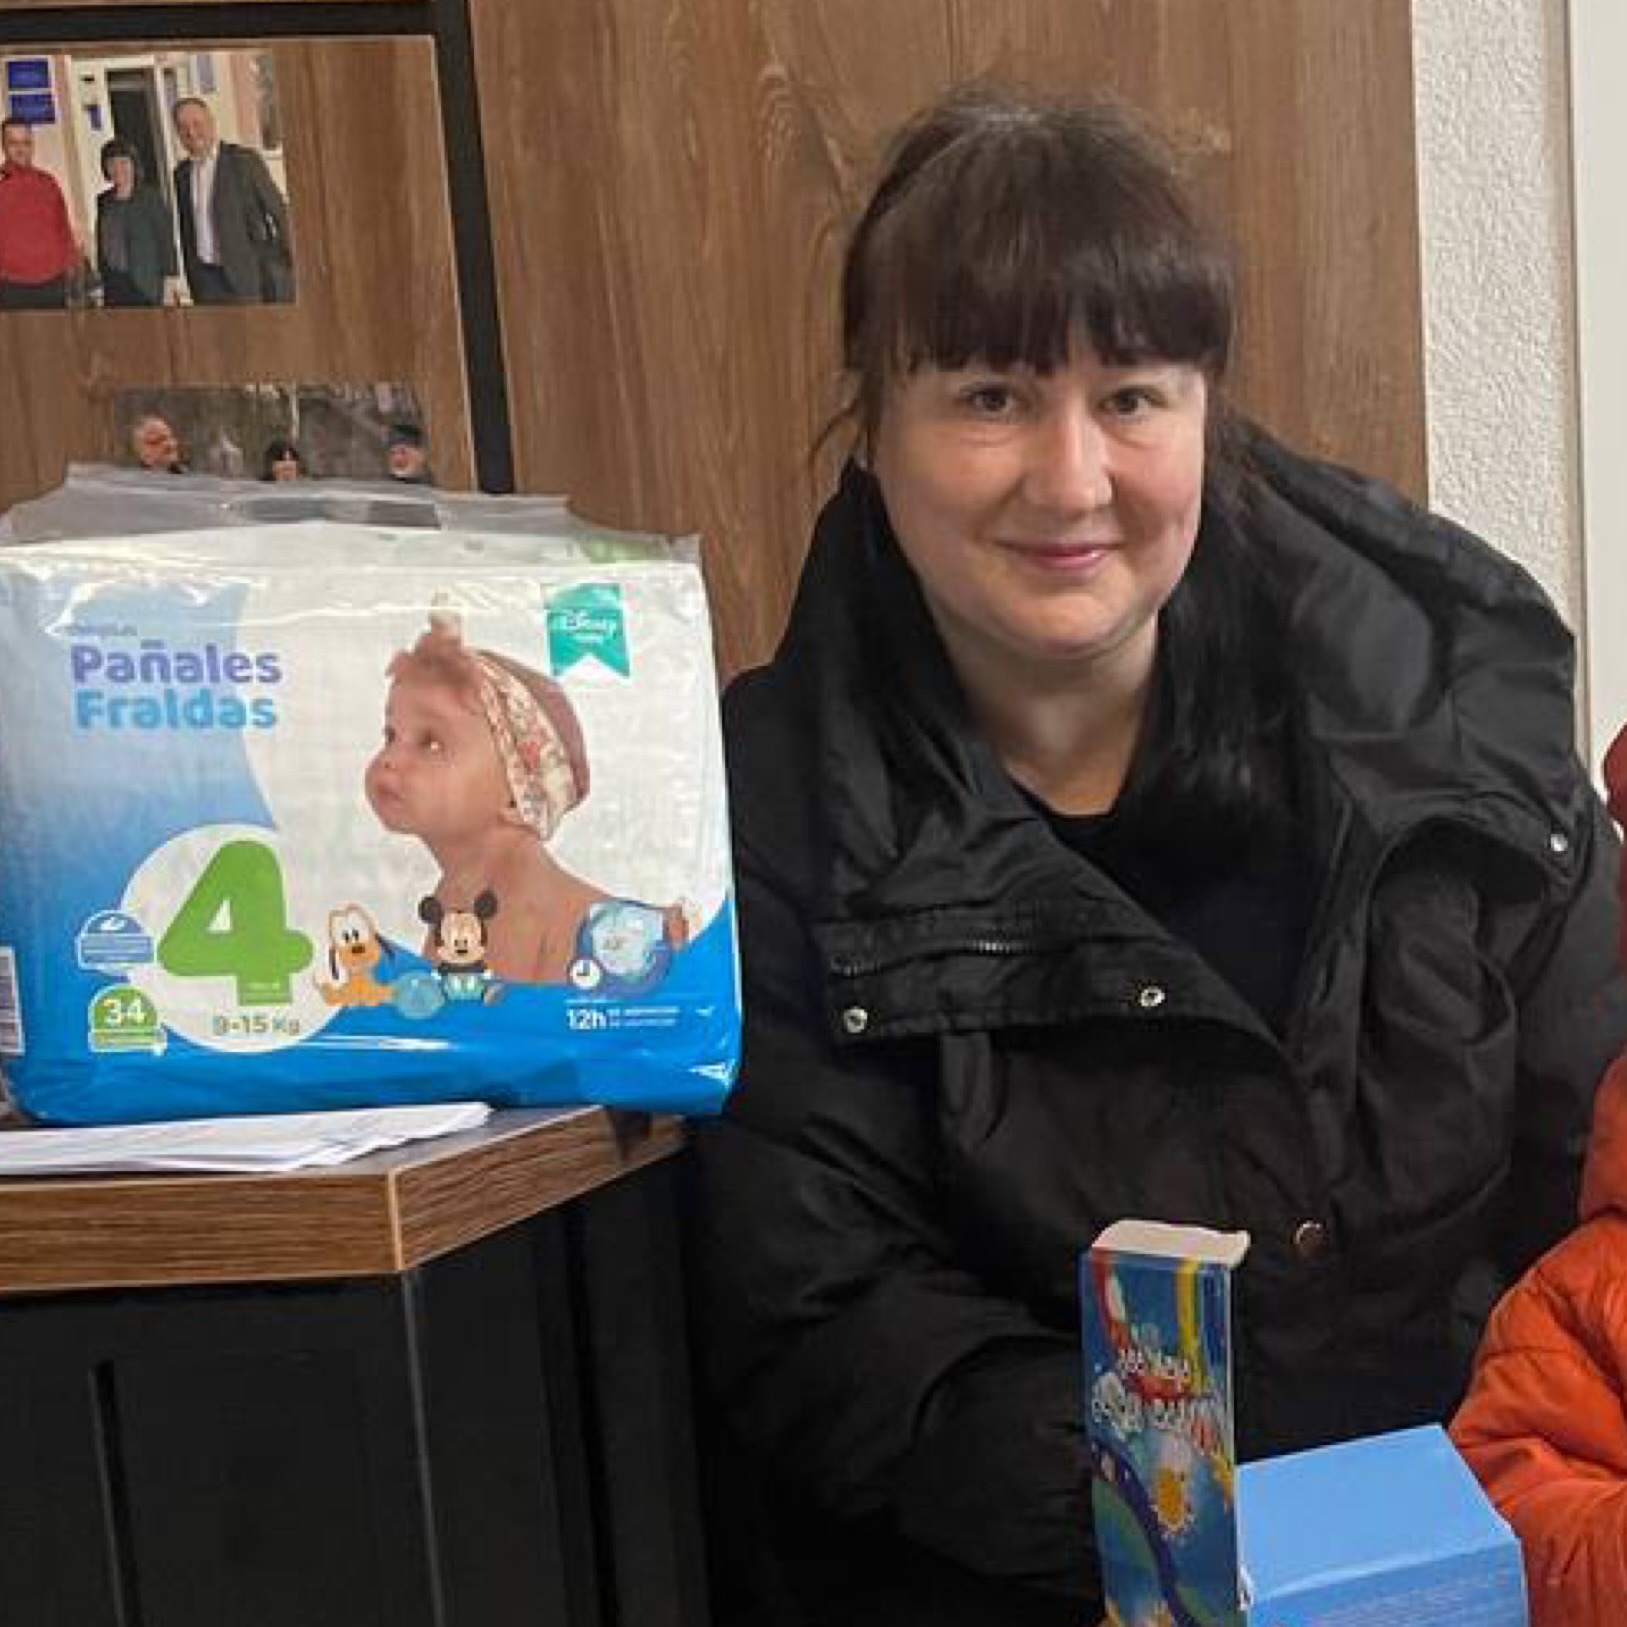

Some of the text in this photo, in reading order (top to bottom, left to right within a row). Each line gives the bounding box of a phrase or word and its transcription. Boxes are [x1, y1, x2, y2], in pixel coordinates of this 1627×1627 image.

[71, 639, 283, 684] Pañales
[75, 688, 278, 730] Fraldas
[156, 840, 314, 1007] 4
